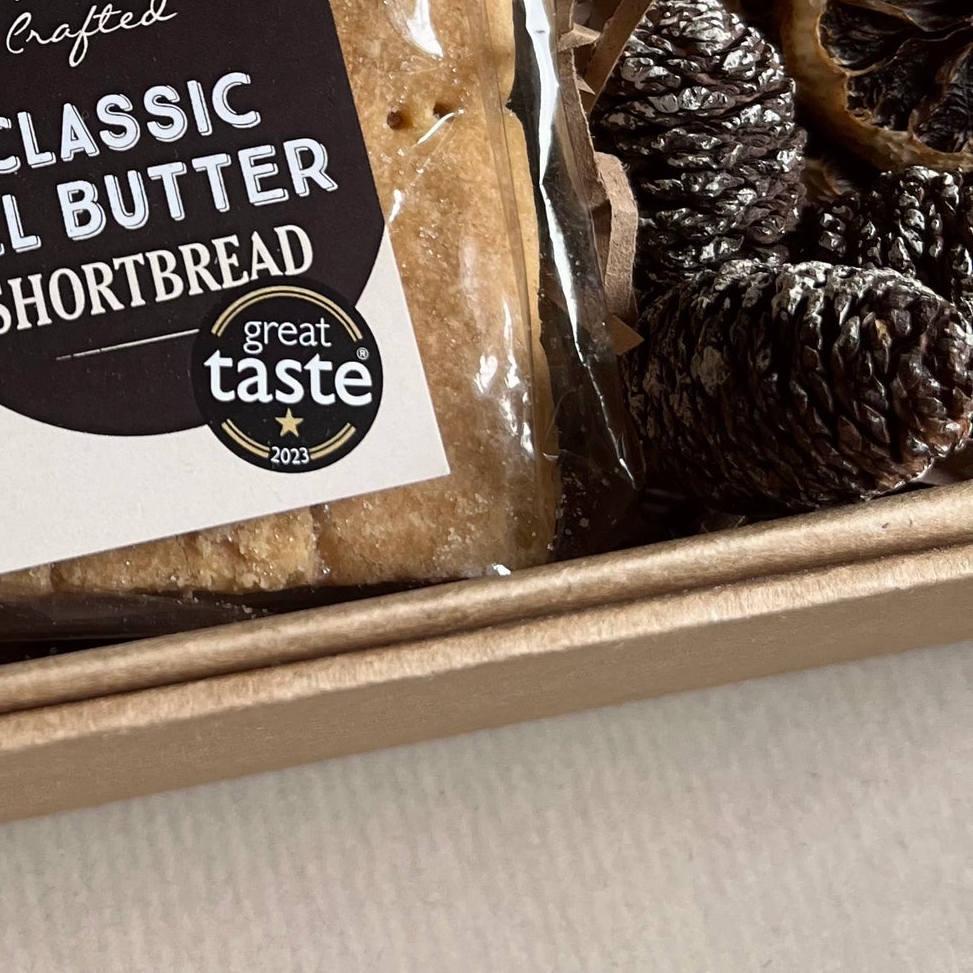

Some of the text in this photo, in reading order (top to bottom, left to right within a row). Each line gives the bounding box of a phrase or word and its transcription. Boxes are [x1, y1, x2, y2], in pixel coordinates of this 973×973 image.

[56, 137, 339, 241] BUTTER
[243, 316, 332, 350] great
[203, 348, 373, 407] taste
[270, 445, 310, 465] 2023
